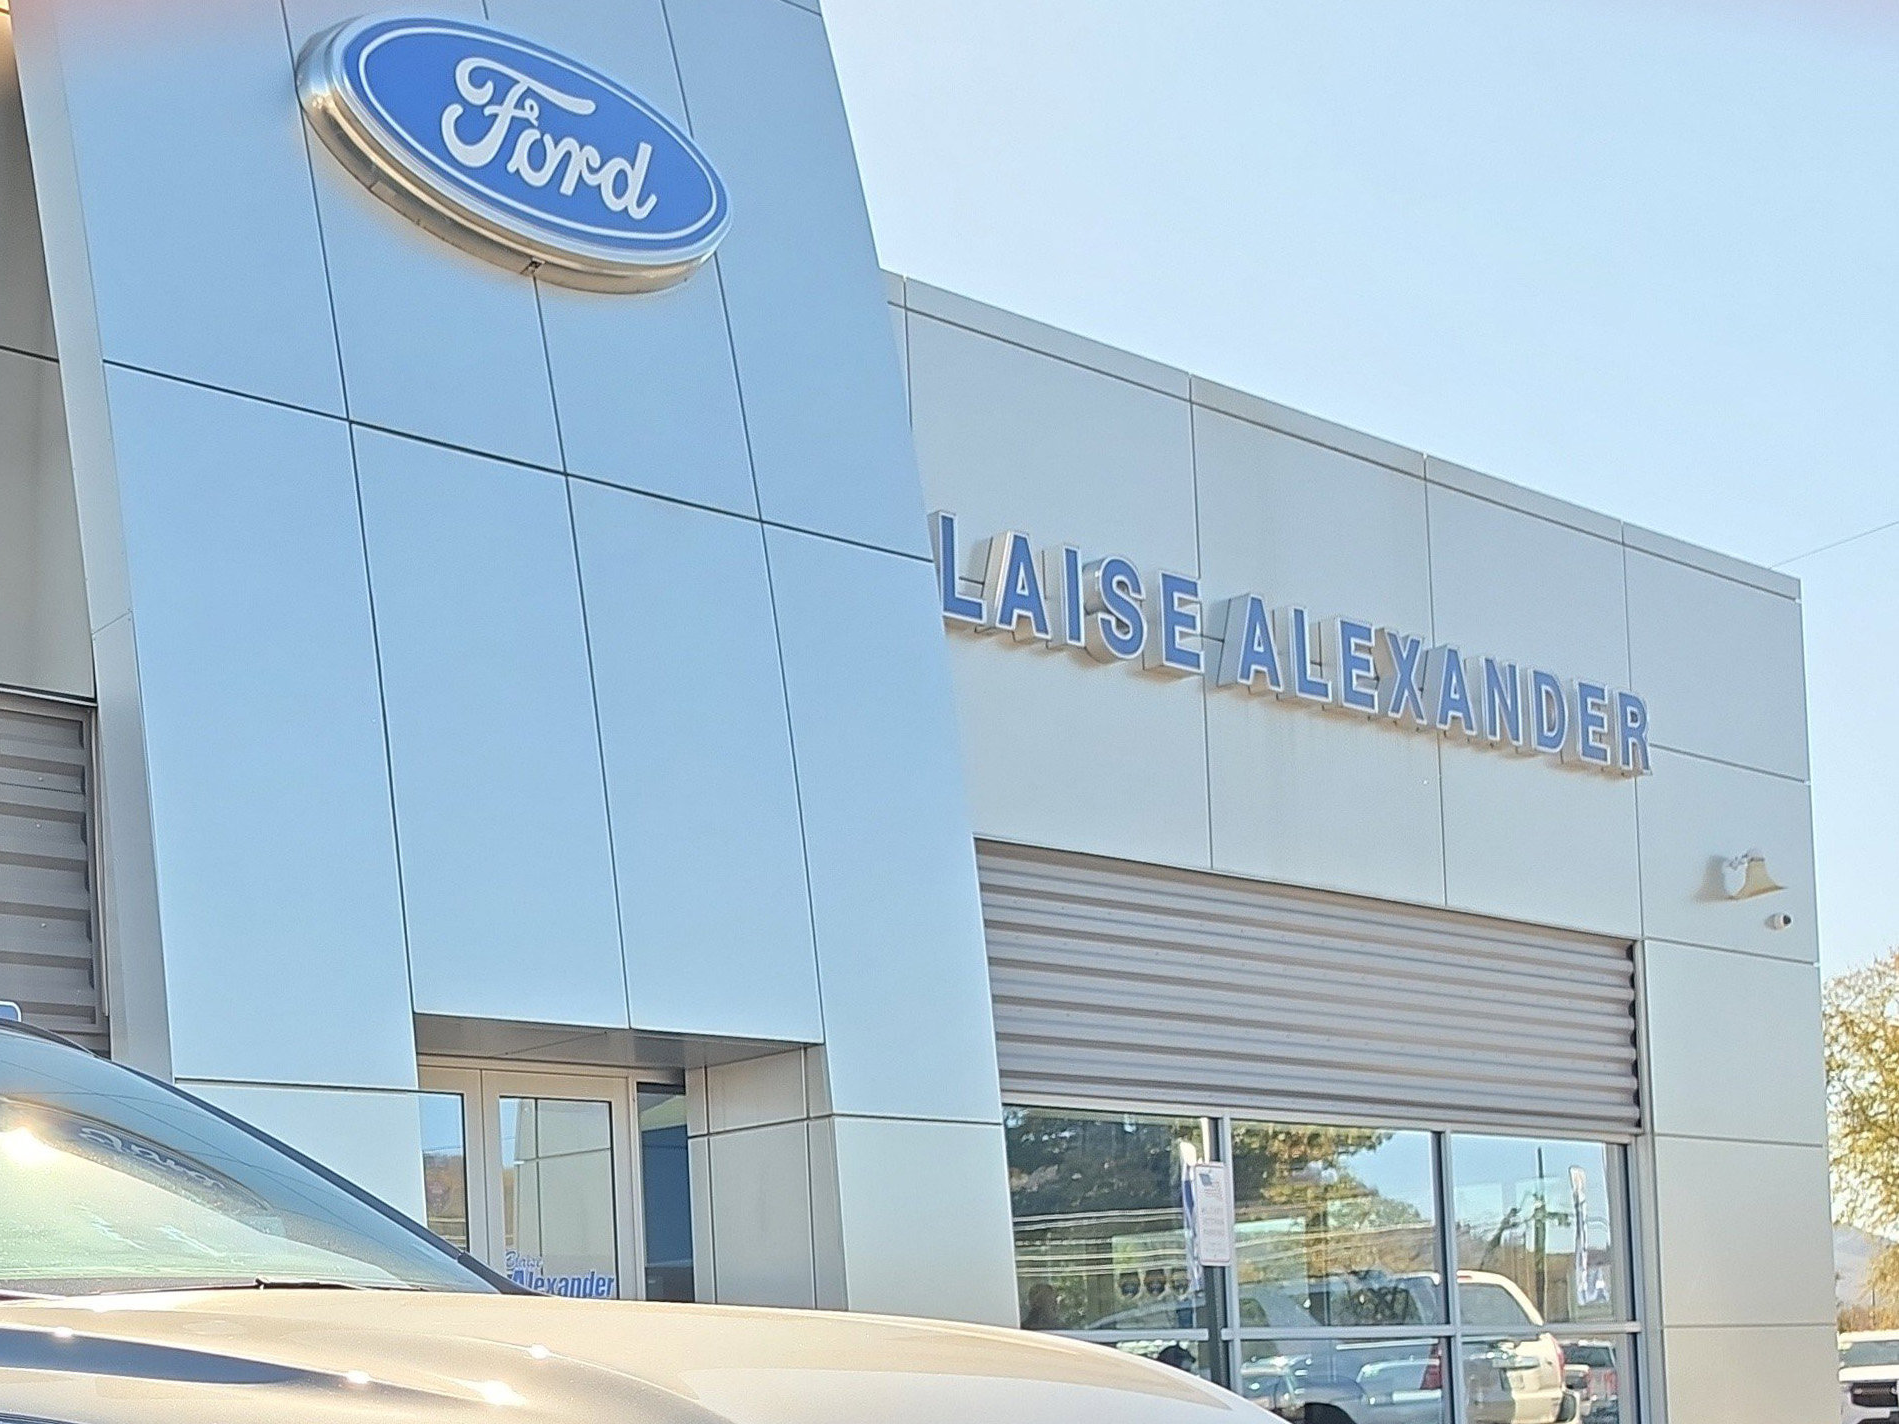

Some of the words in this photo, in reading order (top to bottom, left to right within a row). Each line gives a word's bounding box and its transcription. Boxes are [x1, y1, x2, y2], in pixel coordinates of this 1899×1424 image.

[440, 56, 658, 221] Ford
[1236, 593, 1651, 775] ALEXANDER
[512, 1270, 616, 1298] Alexander
